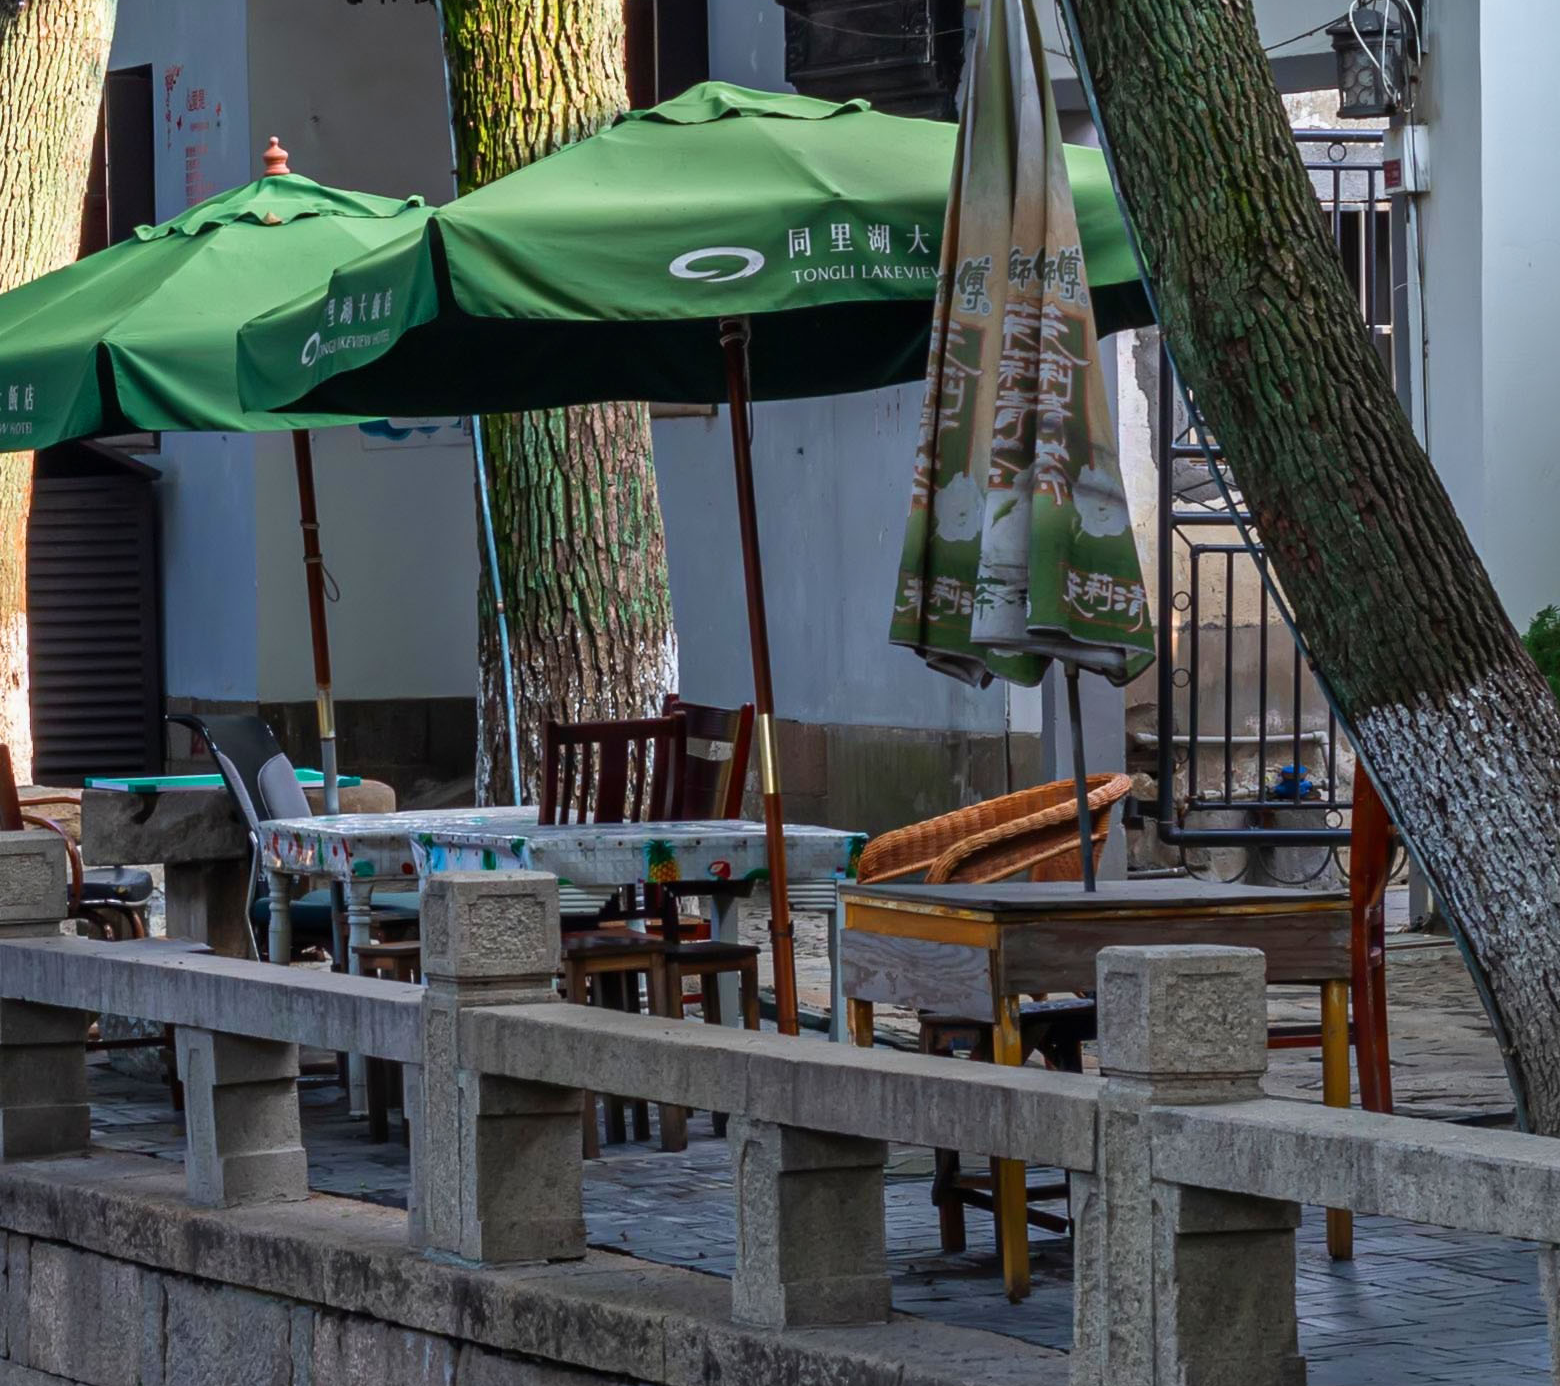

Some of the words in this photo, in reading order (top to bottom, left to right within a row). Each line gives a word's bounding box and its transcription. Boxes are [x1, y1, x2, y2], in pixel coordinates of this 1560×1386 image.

[788, 223, 930, 258] 同里湖大
[792, 265, 855, 283] TONGLI
